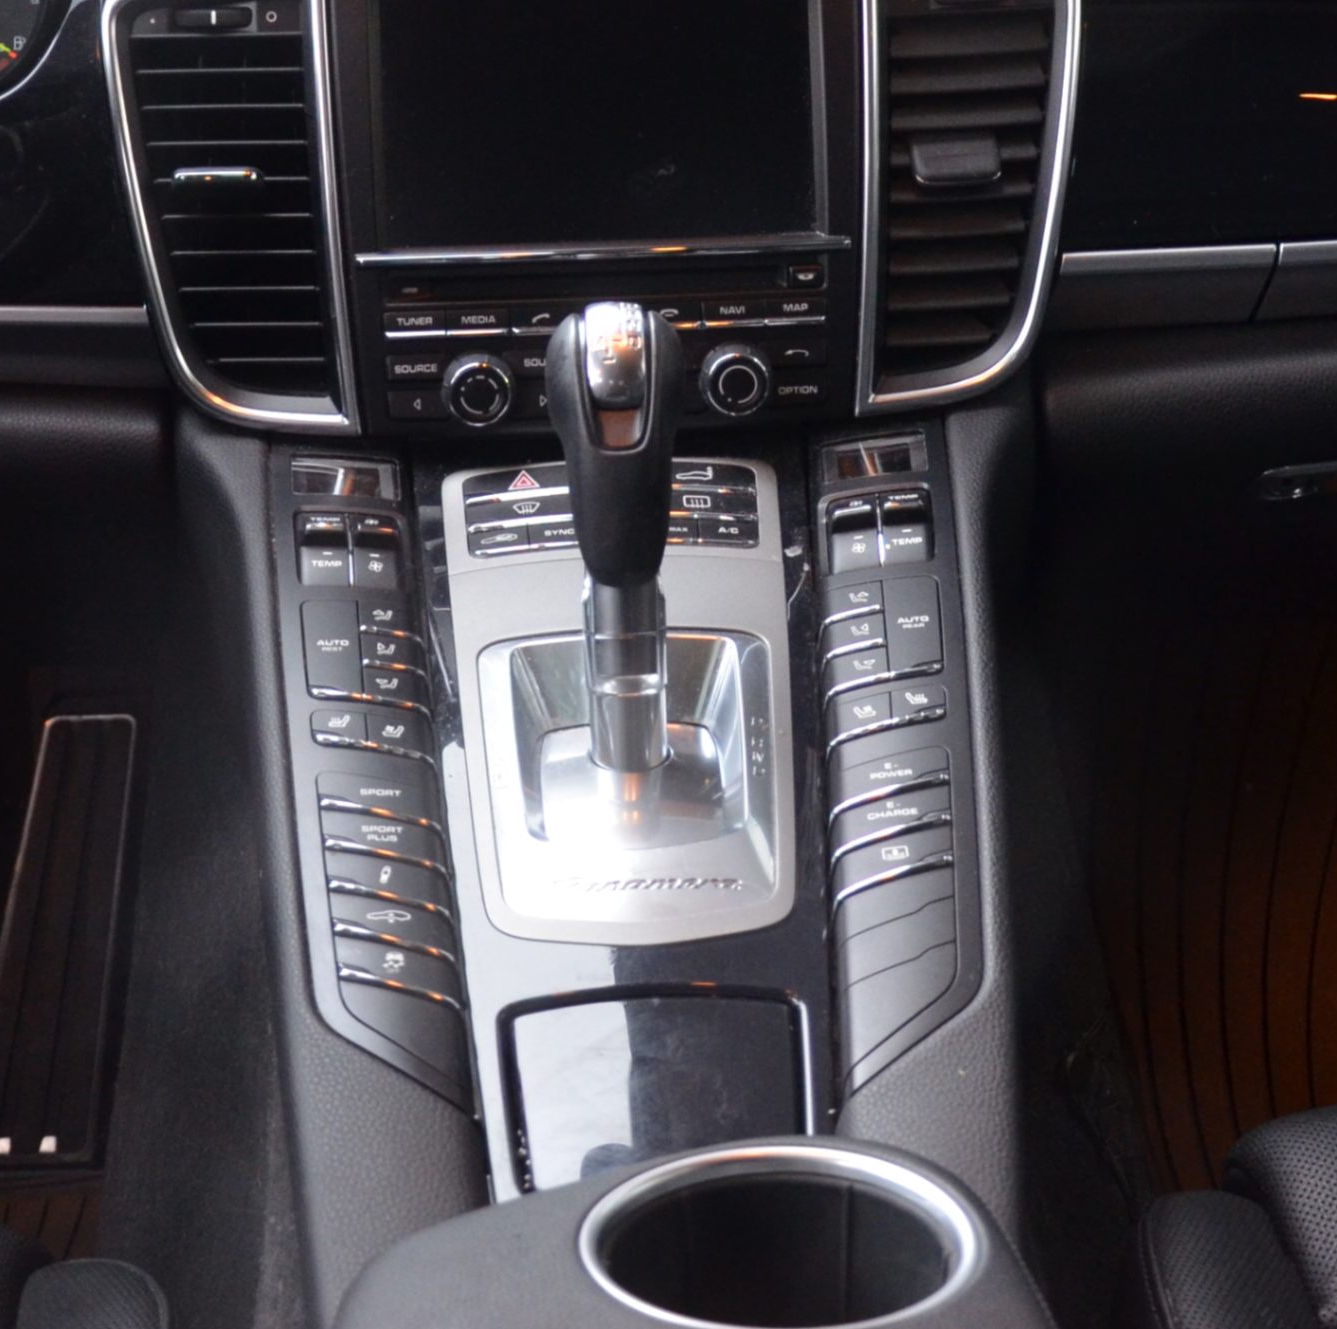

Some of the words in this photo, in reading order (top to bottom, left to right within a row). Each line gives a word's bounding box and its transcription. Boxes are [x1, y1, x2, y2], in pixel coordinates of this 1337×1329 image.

[719, 305, 746, 315] NAVI
[783, 303, 809, 313] MAP
[397, 316, 433, 326] TUNER
[461, 315, 497, 325] MEDIA
[394, 363, 438, 374] SOURCE
[777, 385, 819, 395] OPTION
[718, 526, 739, 535] A/C
[891, 536, 923, 547] TEMP
[311, 559, 343, 568] TEMP
[897, 615, 930, 624] AUTO
[316, 639, 350, 647] AUTO
[869, 769, 913, 780] POWER
[359, 787, 402, 797] SPORT
[866, 807, 919, 821] CHARGE
[361, 824, 404, 834] SPORT
[366, 834, 399, 843] PLUS
